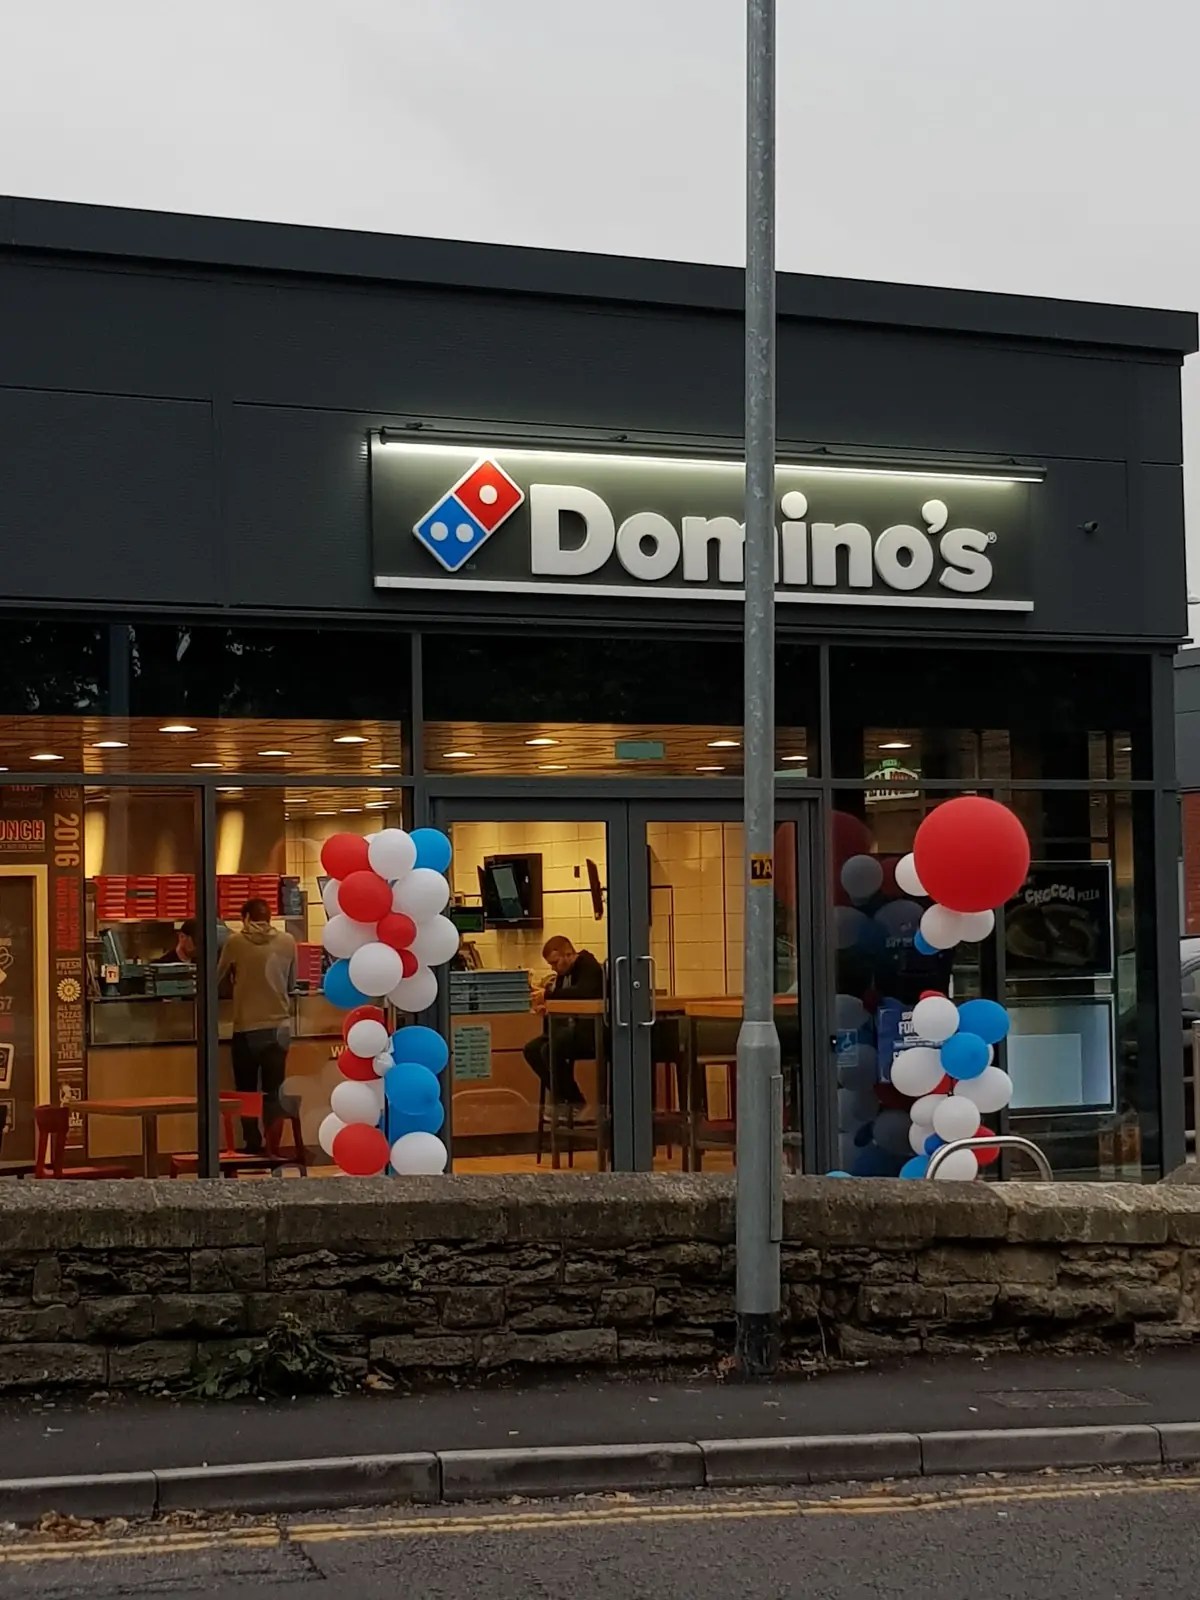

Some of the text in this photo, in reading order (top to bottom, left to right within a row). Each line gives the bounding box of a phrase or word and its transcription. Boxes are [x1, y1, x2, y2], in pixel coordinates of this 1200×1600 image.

[529, 483, 993, 593] Domino's
[54, 813, 79, 867] 2016
[753, 860, 772, 876] 1A
